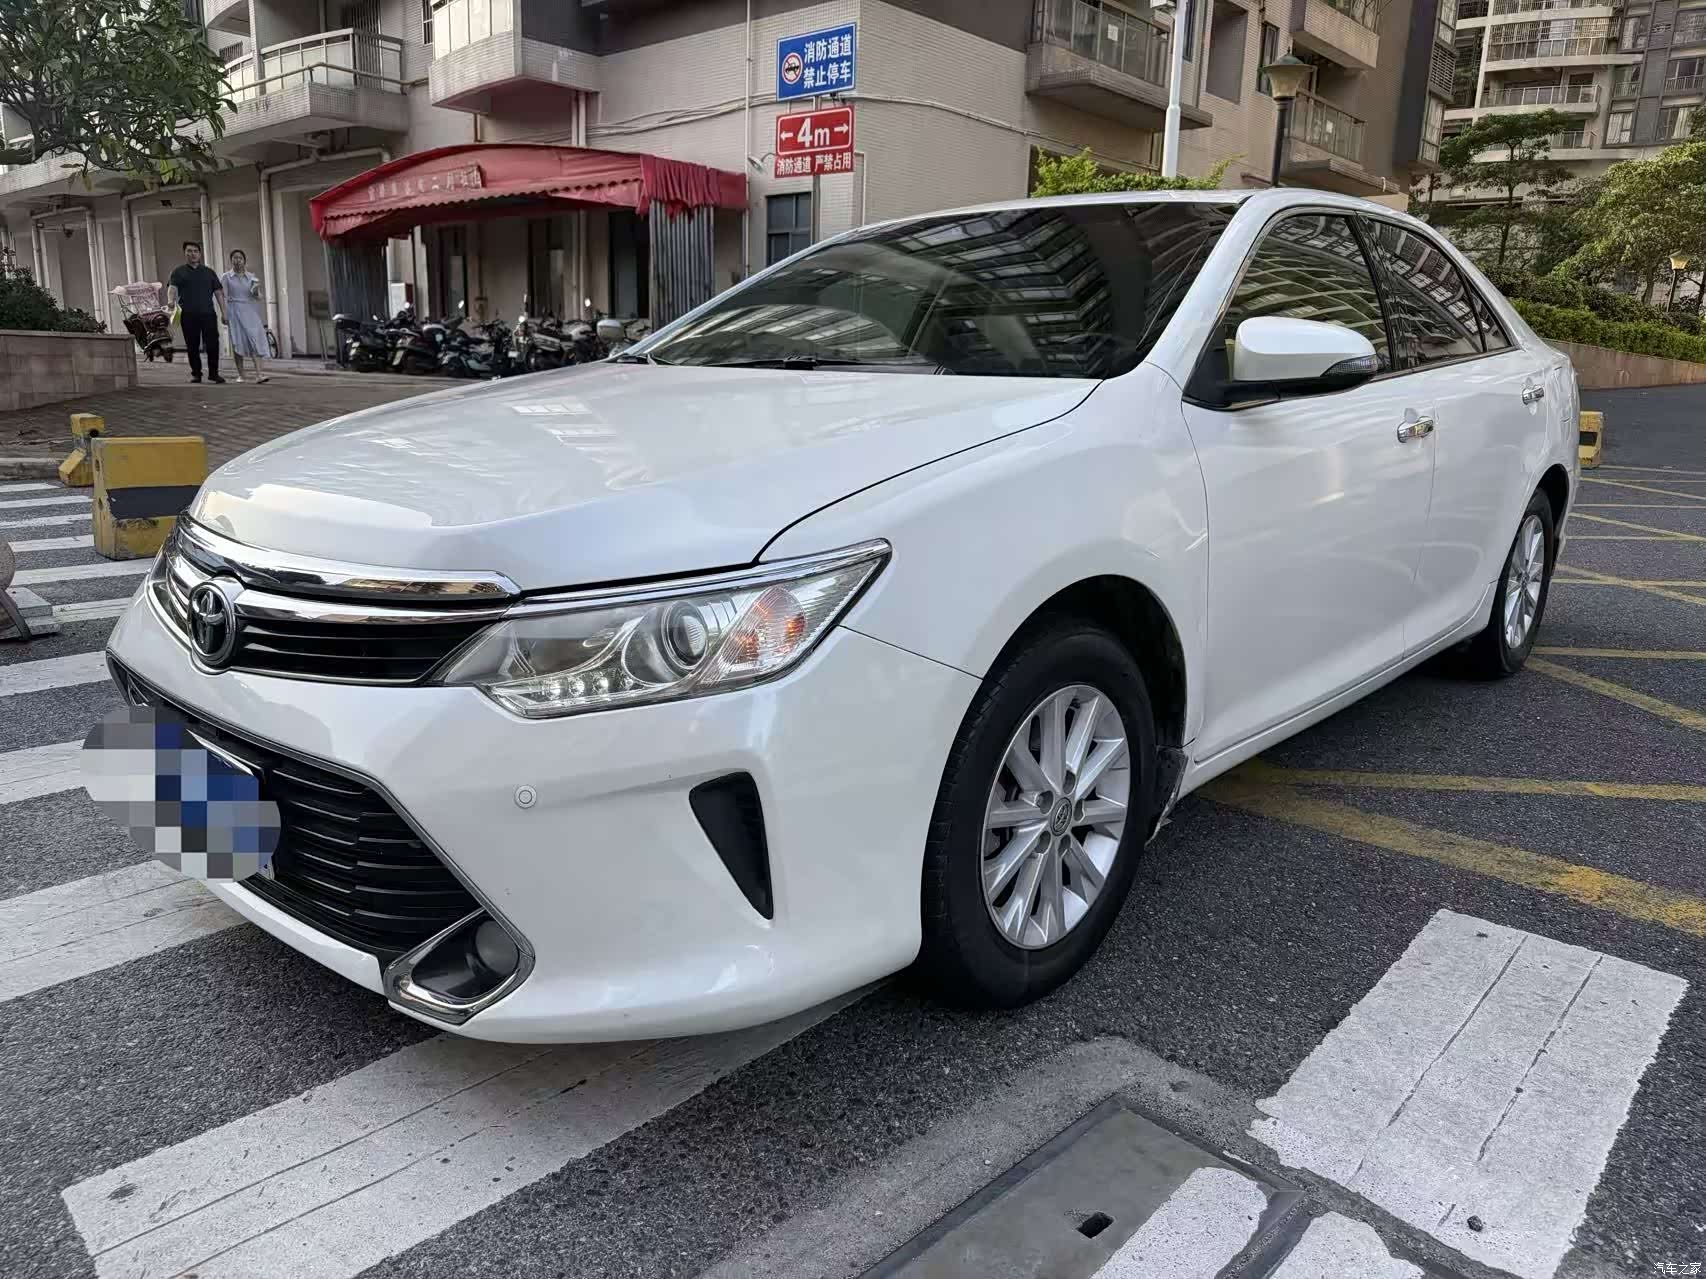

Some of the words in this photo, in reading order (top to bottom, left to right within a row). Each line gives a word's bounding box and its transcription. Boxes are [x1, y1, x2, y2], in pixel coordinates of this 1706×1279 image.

[804, 33, 852, 63] 消防通道
[803, 60, 852, 89] 禁止停车
[797, 117, 830, 147] 4m
[776, 155, 811, 175] 消防通道
[814, 152, 851, 172] 严禁占用
